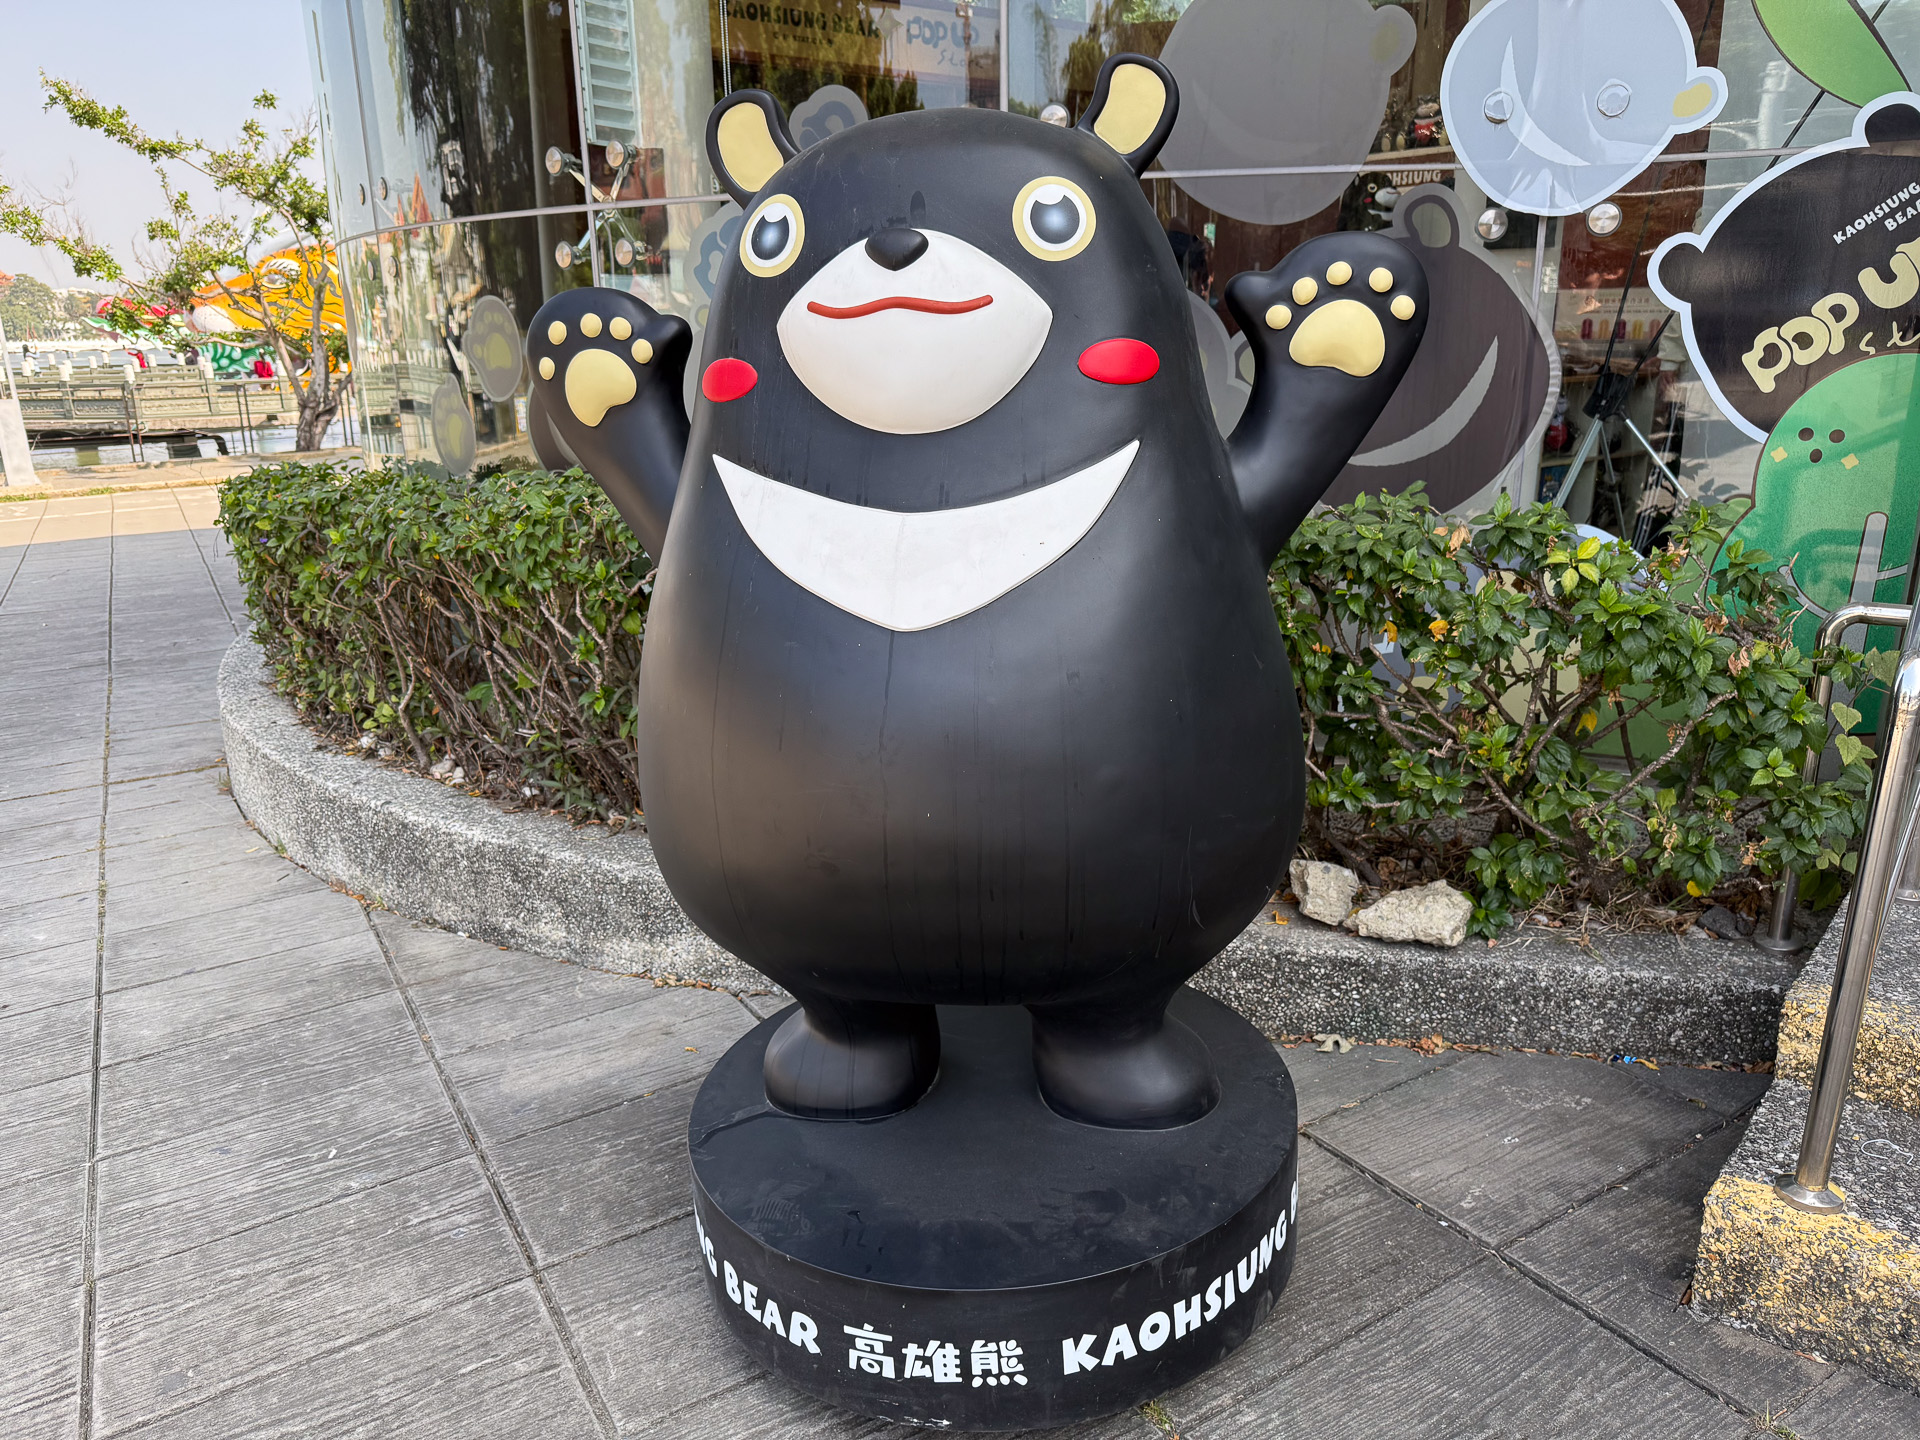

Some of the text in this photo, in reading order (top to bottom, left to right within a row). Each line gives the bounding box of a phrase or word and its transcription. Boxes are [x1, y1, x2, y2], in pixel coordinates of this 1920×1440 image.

[832, 13, 880, 39] BEAR
[907, 16, 948, 48] POP
[1832, 181, 1920, 245] KAOHSIUNG
[1741, 292, 1860, 394] POP
[723, 1259, 821, 1354] BEAR
[1062, 1209, 1287, 1376] KAOHSIUNG
[843, 1322, 1029, 1388] 高雄熊
